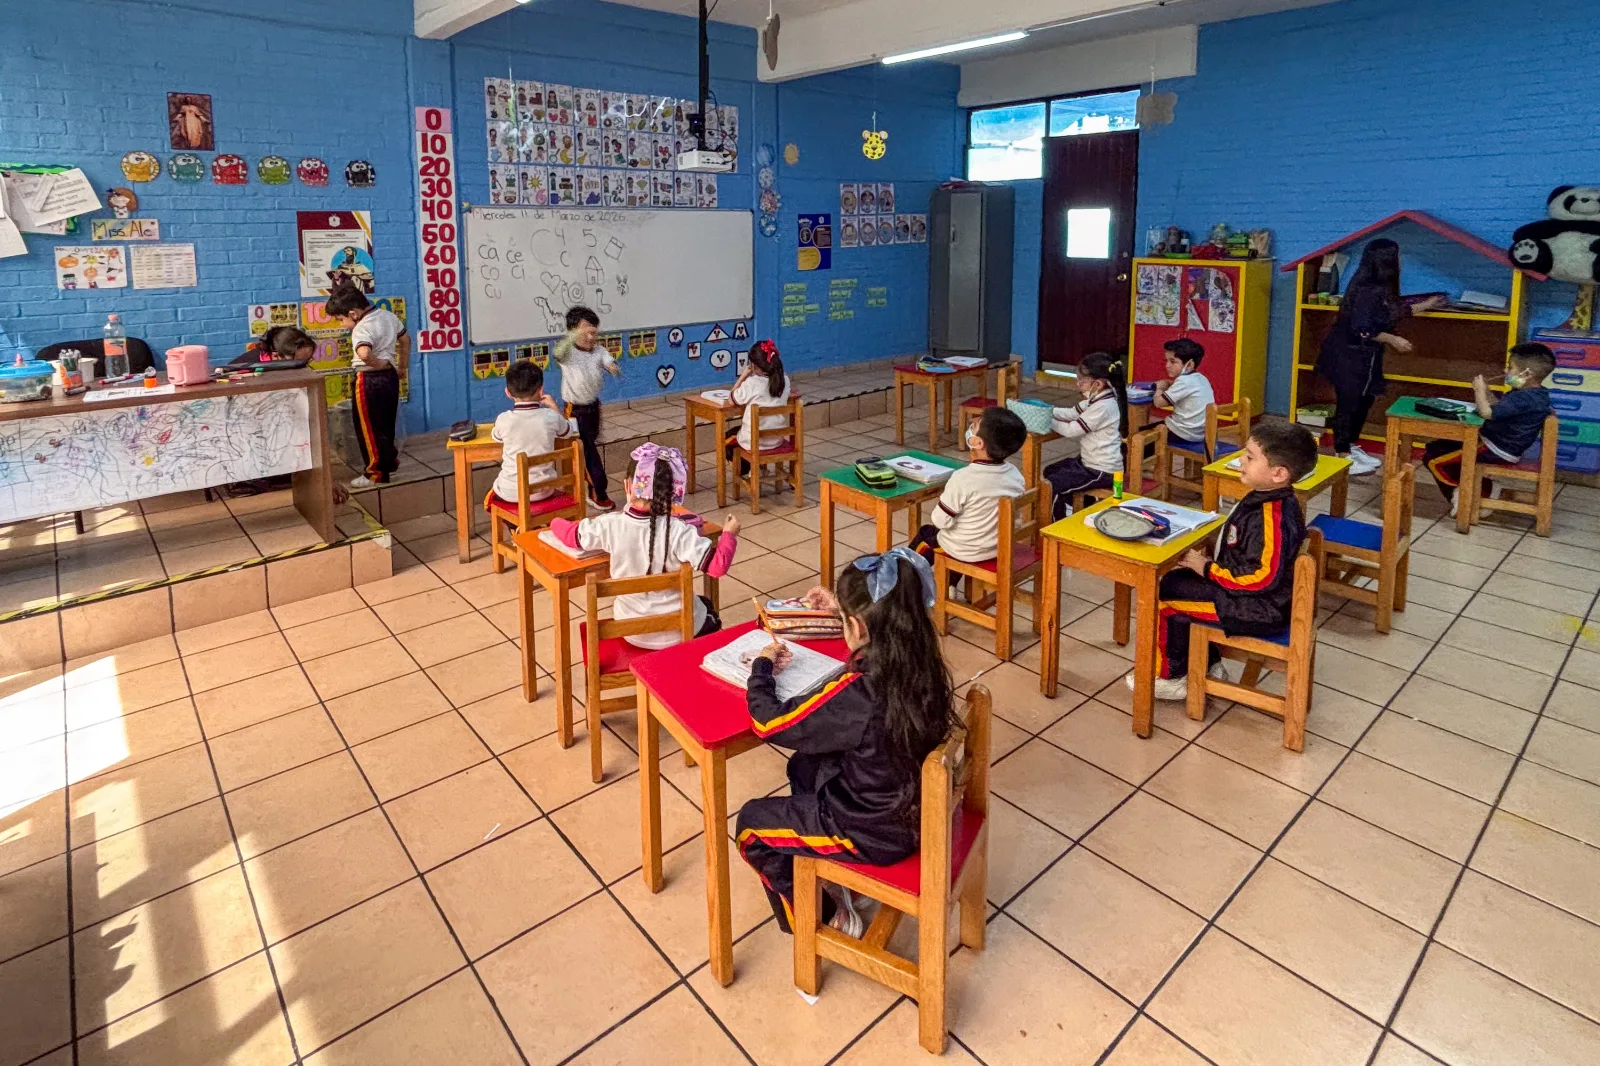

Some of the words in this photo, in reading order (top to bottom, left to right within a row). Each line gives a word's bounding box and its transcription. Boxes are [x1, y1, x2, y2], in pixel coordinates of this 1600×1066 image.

[425, 109, 442, 131] 0
[421, 133, 447, 155] 10
[420, 156, 451, 177] 20
[421, 178, 453, 199] 30
[422, 199, 453, 221] 40
[521, 209, 528, 219] 11
[534, 209, 545, 219] de
[551, 209, 580, 221] Marzo
[584, 210, 595, 221] de
[596, 209, 626, 221] 2026
[93, 221, 126, 237] Miss
[422, 223, 455, 244] 50
[555, 228, 565, 246] 4
[582, 228, 597, 247] 5
[424, 245, 456, 266] 60
[427, 268, 456, 288] 70
[429, 288, 460, 309] 80
[254, 305, 265, 319] 0
[430, 309, 461, 329] 90
[420, 329, 463, 351] 100
[499, 368, 504, 376] 2
